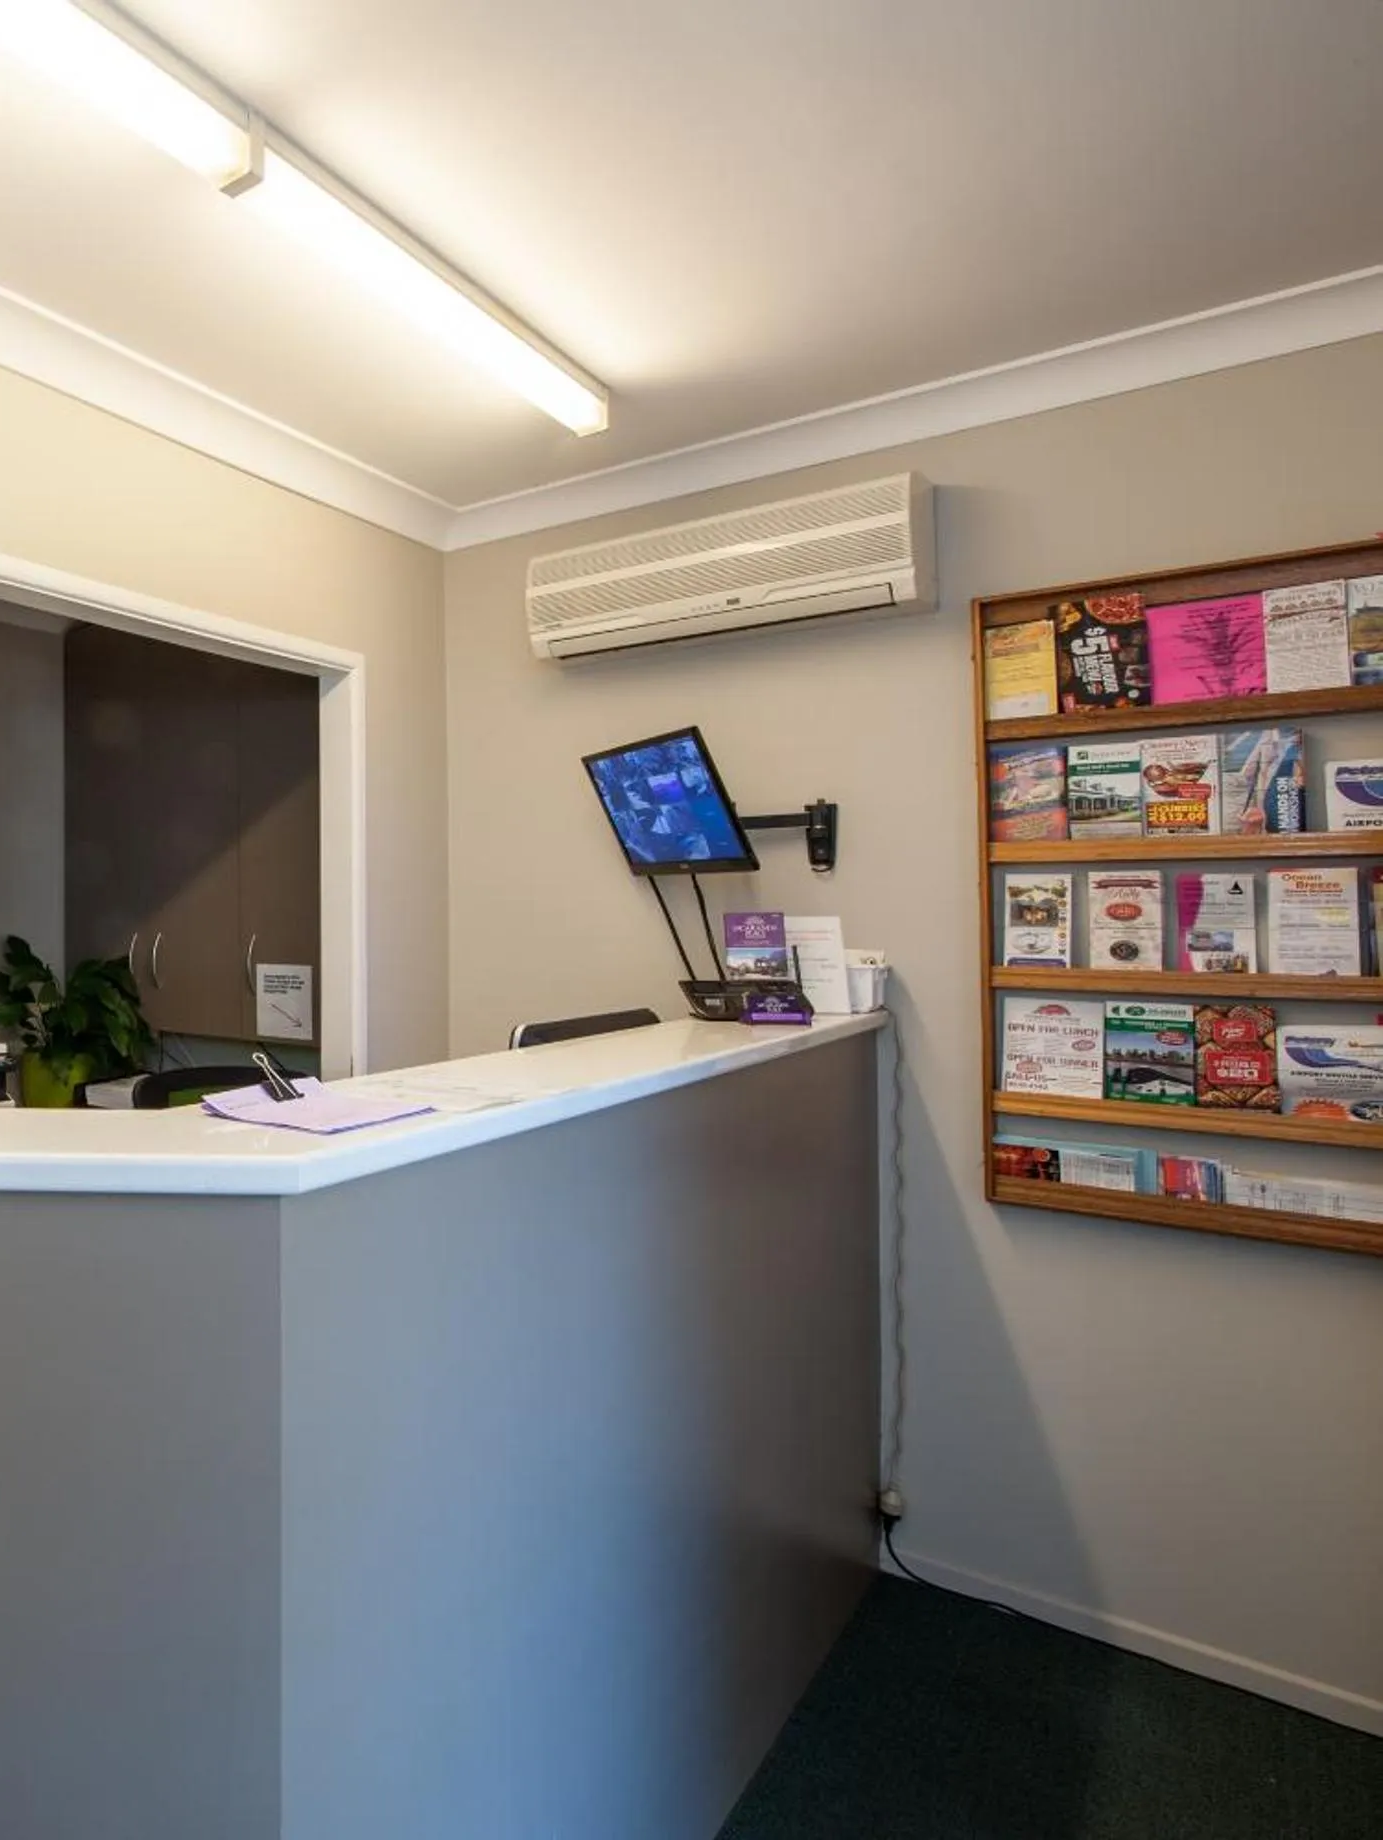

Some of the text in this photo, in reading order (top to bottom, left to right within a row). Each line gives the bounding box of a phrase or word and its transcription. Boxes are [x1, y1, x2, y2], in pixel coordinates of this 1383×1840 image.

[1276, 776, 1288, 791] ON
[1281, 873, 1322, 882] Ocean
[1007, 1022, 1035, 1033] OPEN
[1063, 1027, 1098, 1038] LUNCH
